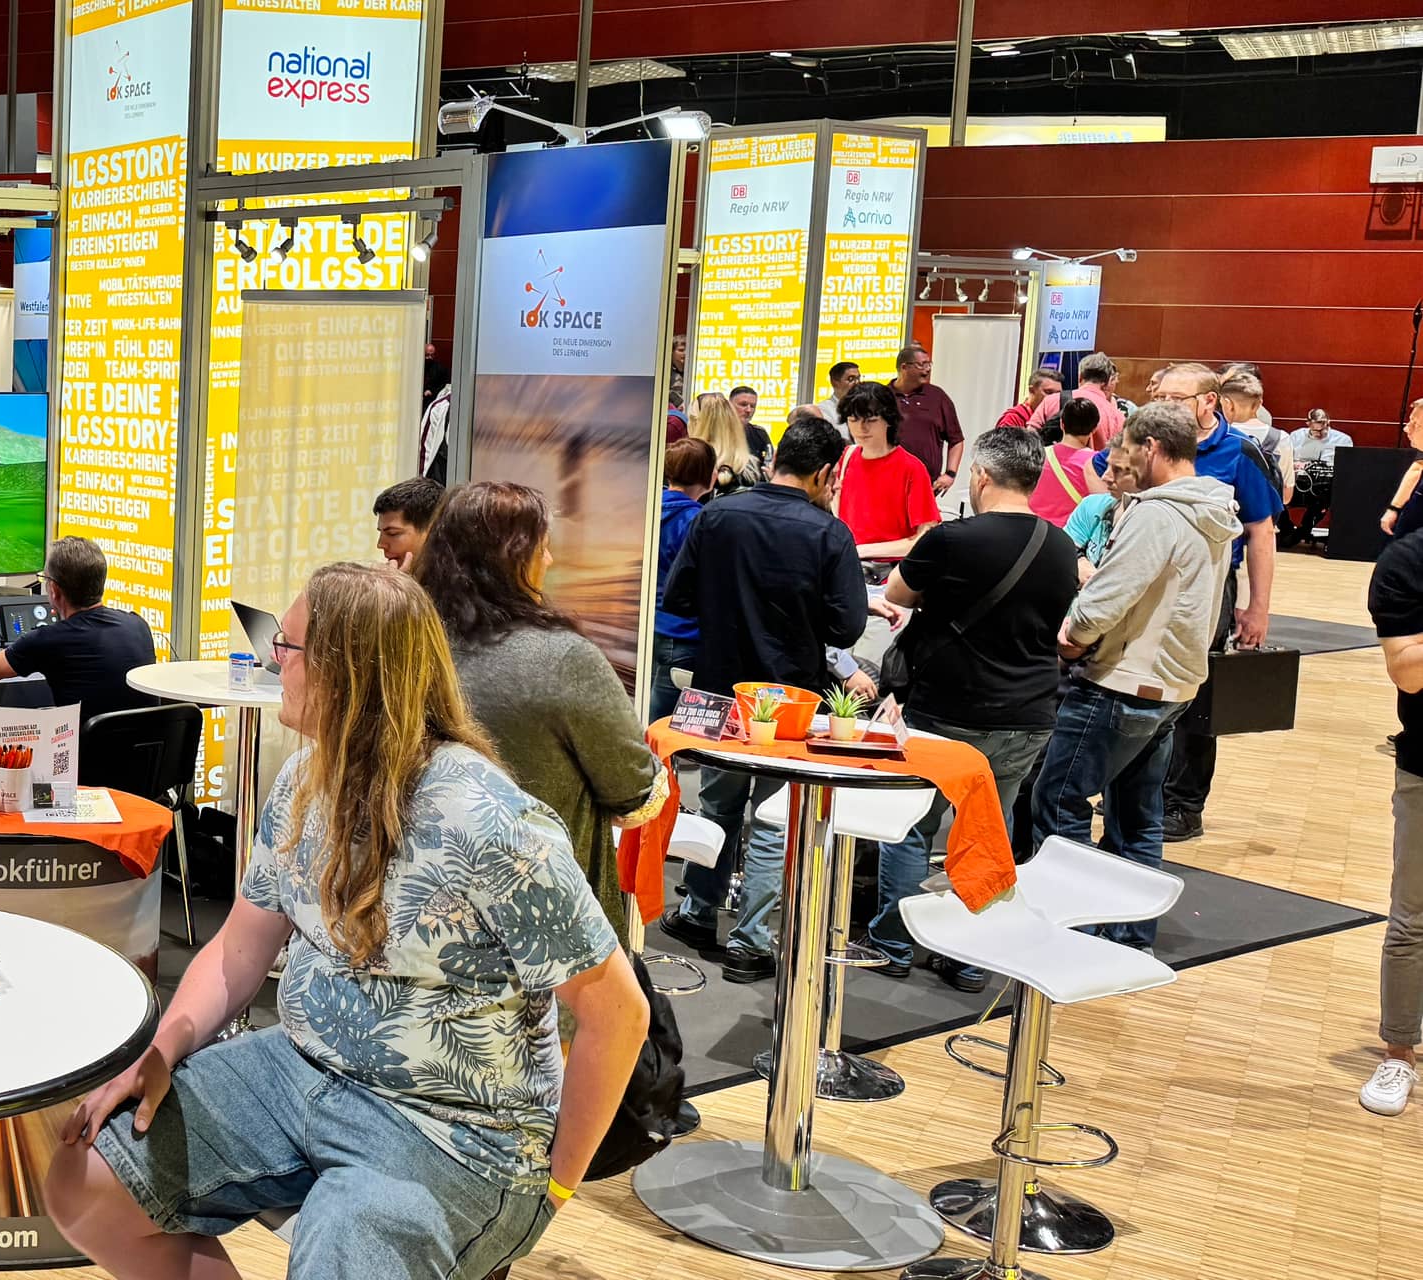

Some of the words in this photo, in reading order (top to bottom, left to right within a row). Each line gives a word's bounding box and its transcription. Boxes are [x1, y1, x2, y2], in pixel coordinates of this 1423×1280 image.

[268, 46, 370, 80] national
[125, 82, 151, 98] SPACE
[268, 77, 369, 107] express
[69, 142, 178, 189] LGSSTORY
[232, 152, 250, 171] IN
[847, 171, 859, 184] DB
[71, 179, 176, 209] KARRIERESCHIENE
[732, 186, 746, 197] DB
[845, 189, 869, 203] Regio
[872, 192, 894, 202] NRW
[730, 202, 758, 216] Regio
[762, 201, 789, 212] NRW
[858, 210, 892, 224] arriva
[82, 210, 132, 232] EINFACH
[228, 221, 354, 254] STARTE
[363, 221, 402, 252] DE
[705, 232, 799, 255] LGSSTORY
[216, 257, 403, 292] ERFOLGSST
[717, 267, 759, 278] EINFACH
[826, 276, 881, 293] STARTE
[885, 276, 902, 293] DE
[107, 291, 172, 306] MITGESTALTEN
[820, 294, 901, 312] ERFOLGSST
[520, 310, 548, 328] LOK
[553, 311, 602, 329] SPACE
[1050, 309, 1070, 321] Regio
[1072, 309, 1091, 320] NRW
[85, 319, 107, 336] ZEIT
[318, 317, 397, 336] EINFACH
[1061, 326, 1089, 340] arriva
[114, 335, 145, 358] FÜHL
[149, 340, 173, 358] DEN
[579, 339, 612, 348] DIMENSION
[564, 349, 589, 358] LERNENS
[731, 360, 783, 377] DEINE
[102, 382, 162, 415] DEINE
[61, 414, 170, 451] LGSSTORY
[221, 432, 237, 450] IN
[65, 447, 168, 473] KARRIERESCHIENE
[75, 470, 124, 493] EINFACH
